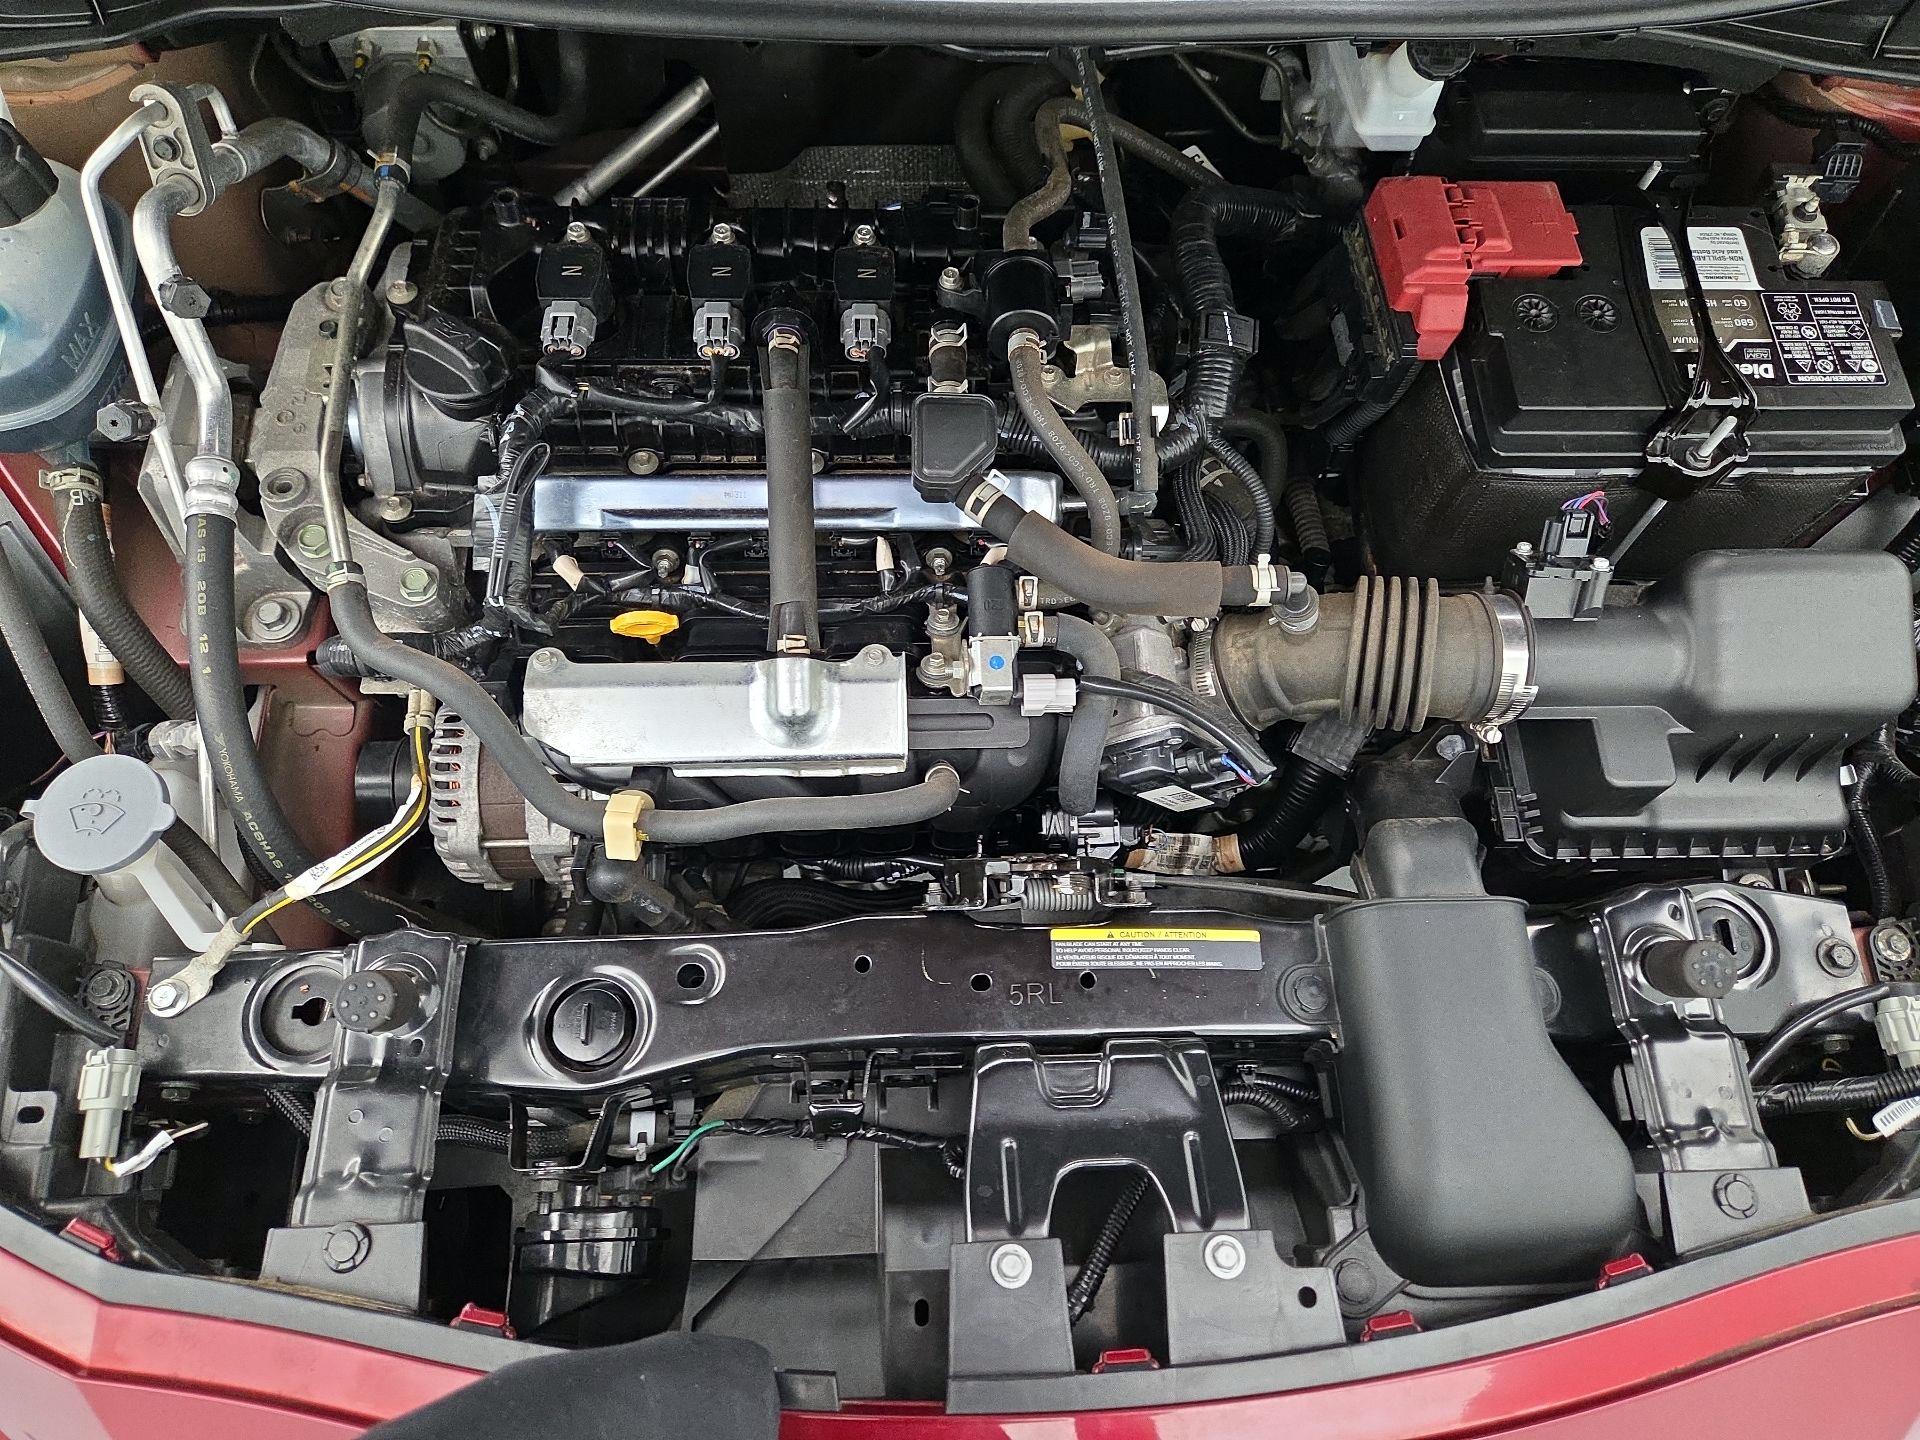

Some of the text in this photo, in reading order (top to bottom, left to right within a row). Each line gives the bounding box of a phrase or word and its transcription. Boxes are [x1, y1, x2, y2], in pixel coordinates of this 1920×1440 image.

[1733, 299, 1748, 307] 60
[1734, 318, 1755, 327] 680
[196, 546, 207, 563] 15
[199, 632, 210, 654] 12
[218, 747, 245, 804] YOKOHAMA
[1119, 931, 1156, 939] CAUTION
[1164, 931, 1207, 939] ATTENTION
[1008, 982, 1064, 1007] 5RL
